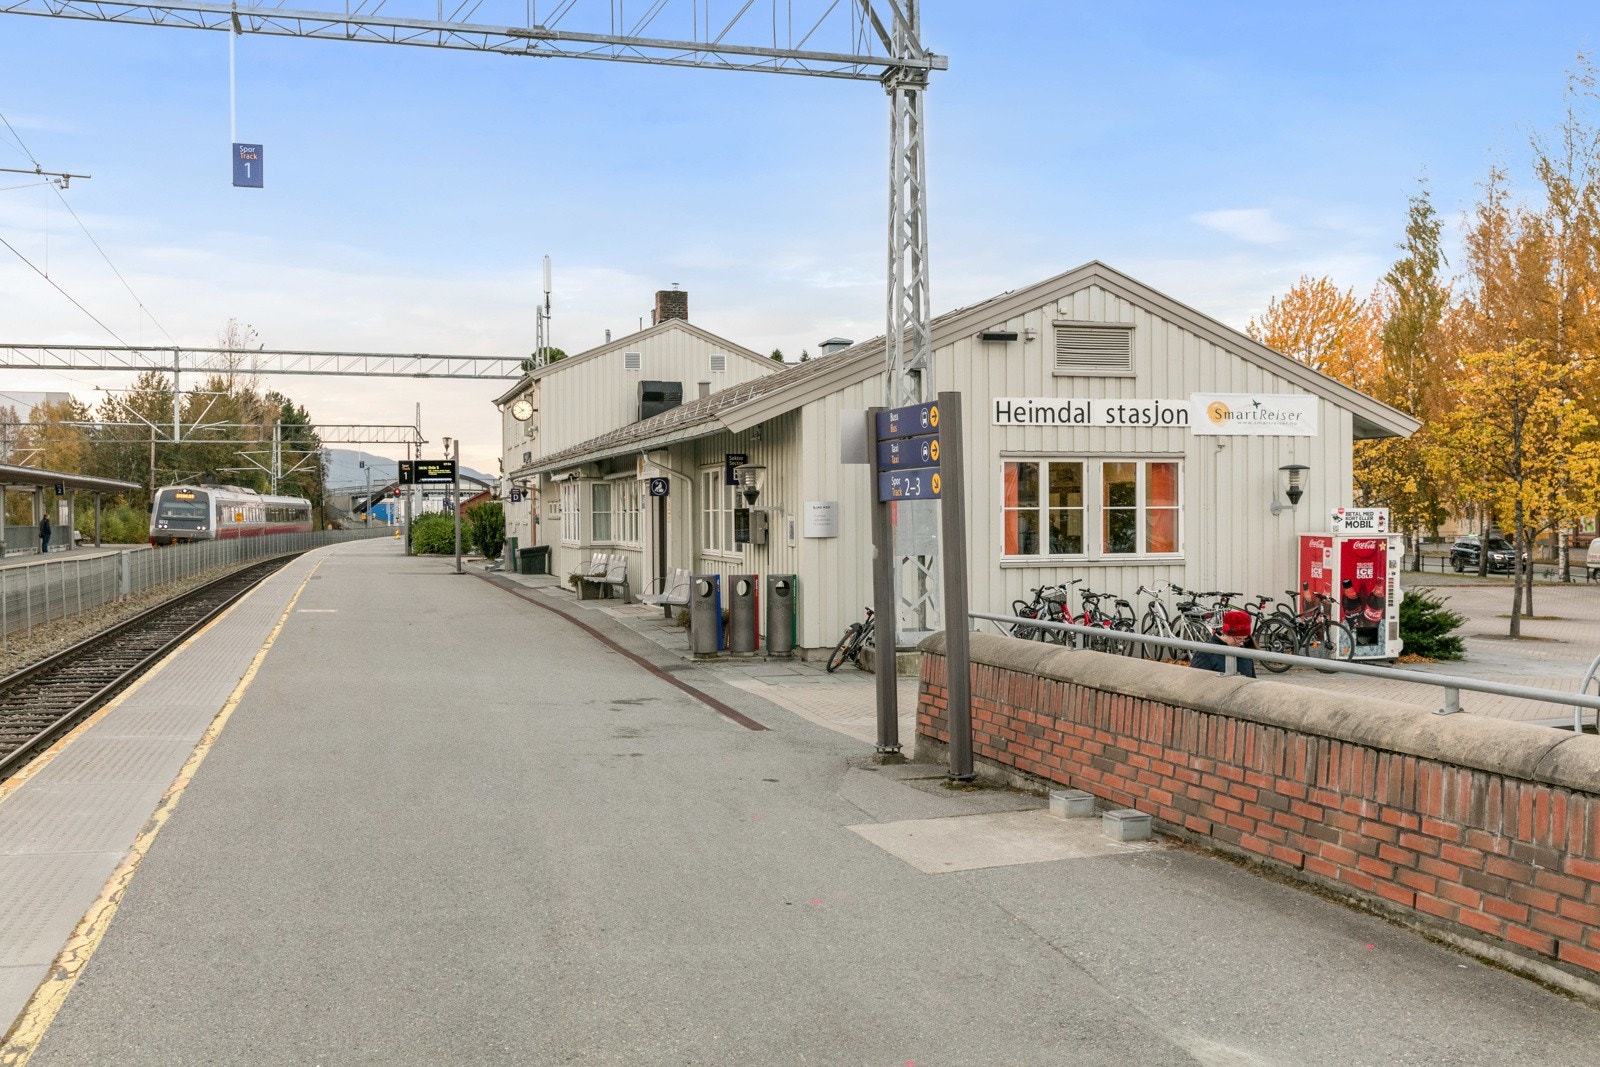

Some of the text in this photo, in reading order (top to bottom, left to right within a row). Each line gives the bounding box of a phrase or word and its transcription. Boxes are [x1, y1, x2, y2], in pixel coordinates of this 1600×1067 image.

[239, 145, 256, 153] Spor
[240, 152, 258, 160] Track
[244, 162, 251, 179] 1
[890, 412, 898, 421] Buss
[996, 400, 1189, 427] Heimdal stasjon
[1214, 408, 1303, 420] SmartReiser
[891, 455, 899, 464] Taxi
[403, 471, 407, 480] 1
[891, 476, 900, 487] Spor
[892, 487, 902, 496] Track
[1345, 520, 1373, 528] MOBIL
[1353, 540, 1376, 549] Coca-Cola
